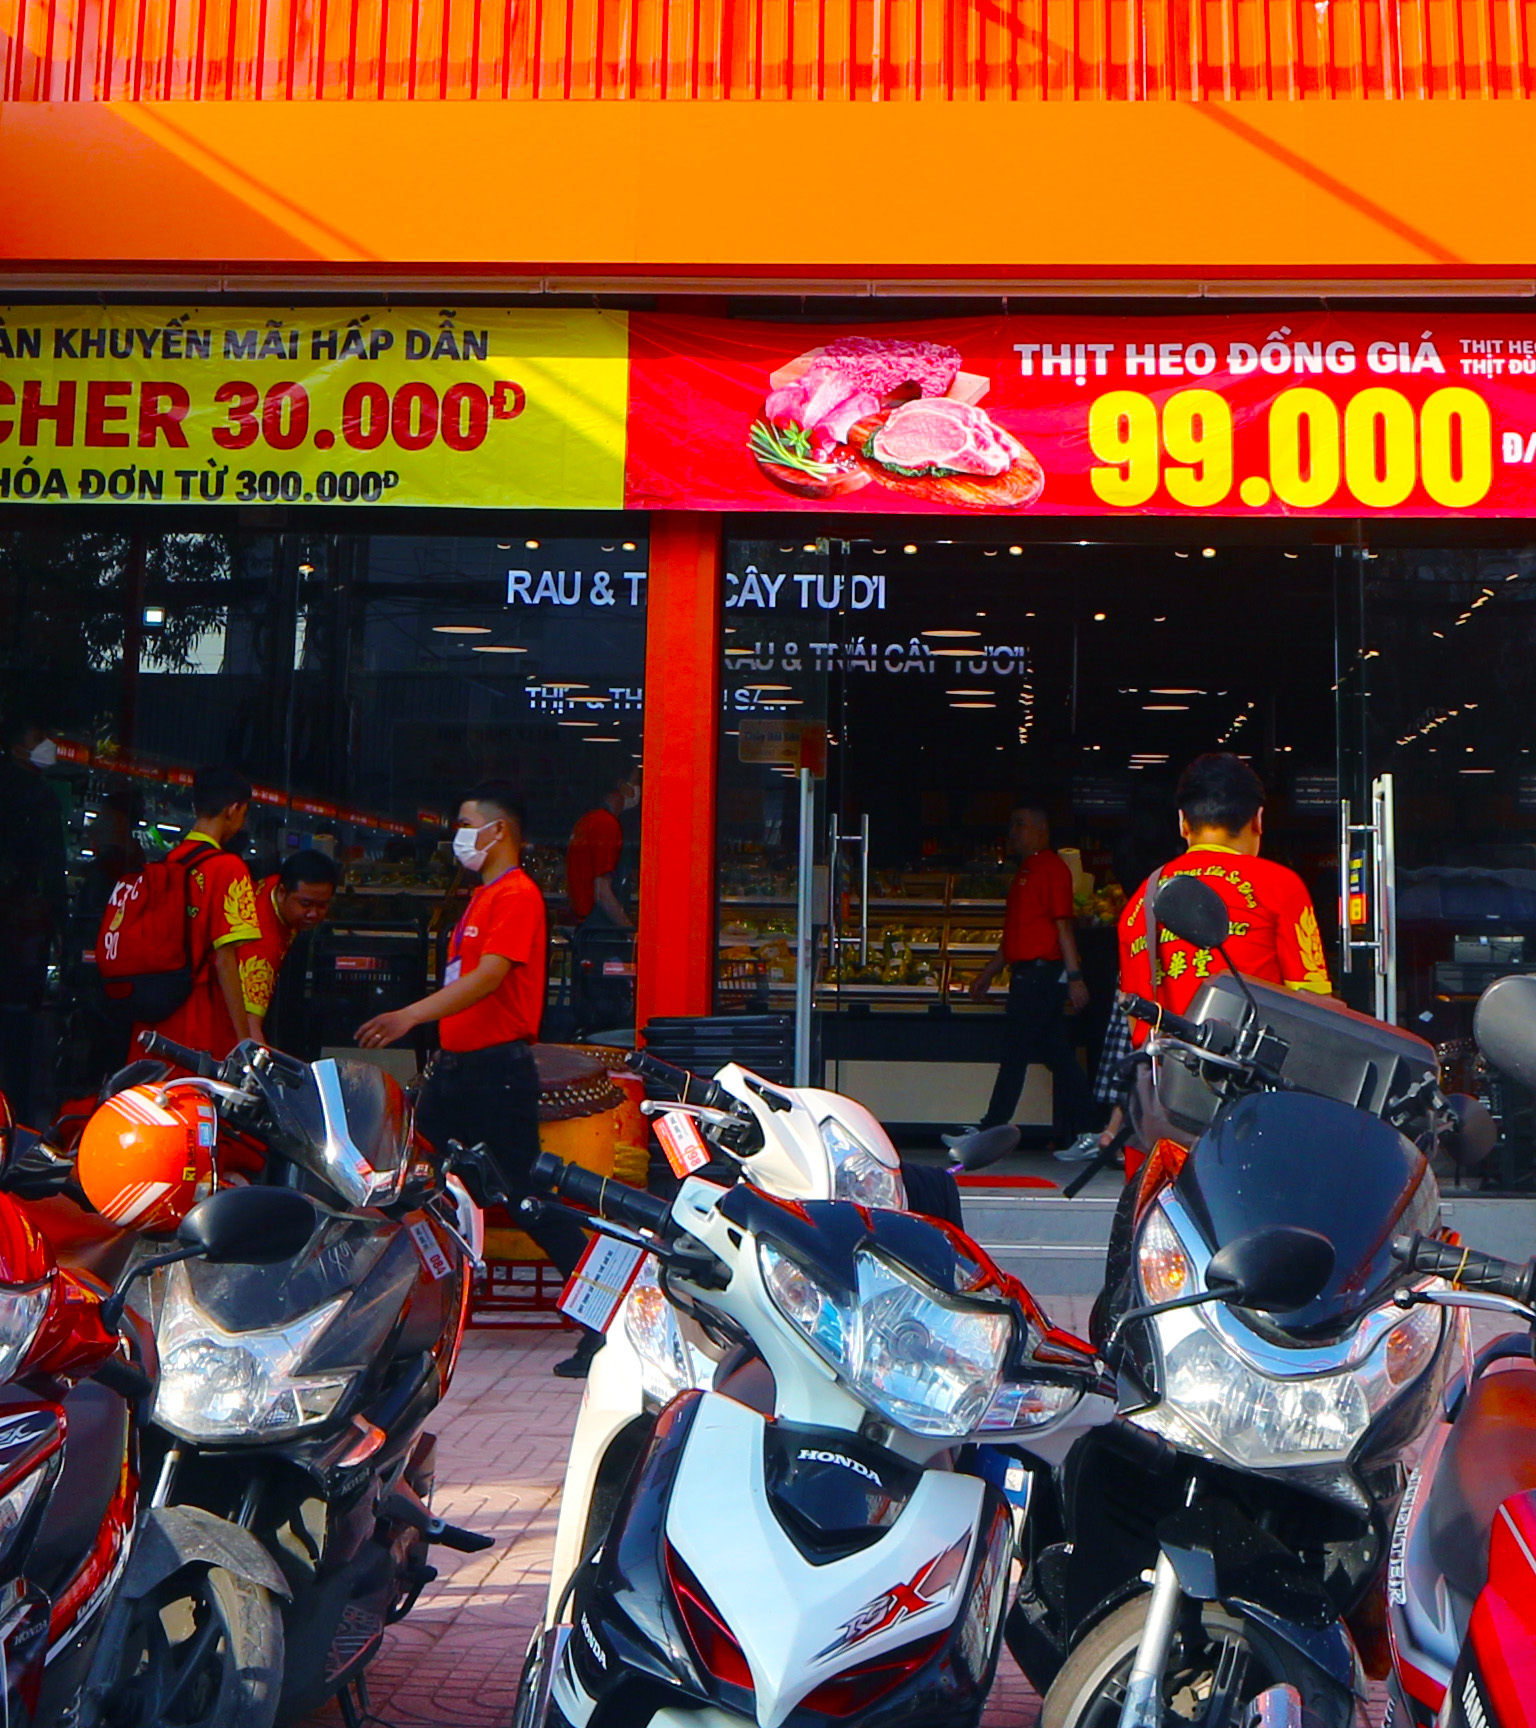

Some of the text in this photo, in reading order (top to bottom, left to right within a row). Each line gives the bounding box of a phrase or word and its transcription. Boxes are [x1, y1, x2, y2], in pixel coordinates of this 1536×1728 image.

[54, 316, 207, 360] KHUYẾN
[224, 320, 297, 361] MÃI
[310, 316, 394, 361] HẤP
[406, 309, 488, 362] DẪN
[1014, 327, 1446, 385] THỊT HEO ĐỒNG GIÁ
[1460, 339, 1504, 357] THỊT
[1460, 358, 1505, 379] THỊT
[1088, 385, 1494, 510] 99.000
[78, 467, 164, 502] ĐƠN
[174, 458, 229, 503] TỪ
[507, 570, 581, 606] RAU
[590, 571, 616, 606] &
[725, 565, 786, 608] CÂY
[725, 642, 774, 671] AU
[797, 1449, 883, 1488] HONDA
[581, 1611, 608, 1672] HONDA
[1462, 1671, 1491, 1728] YAM
